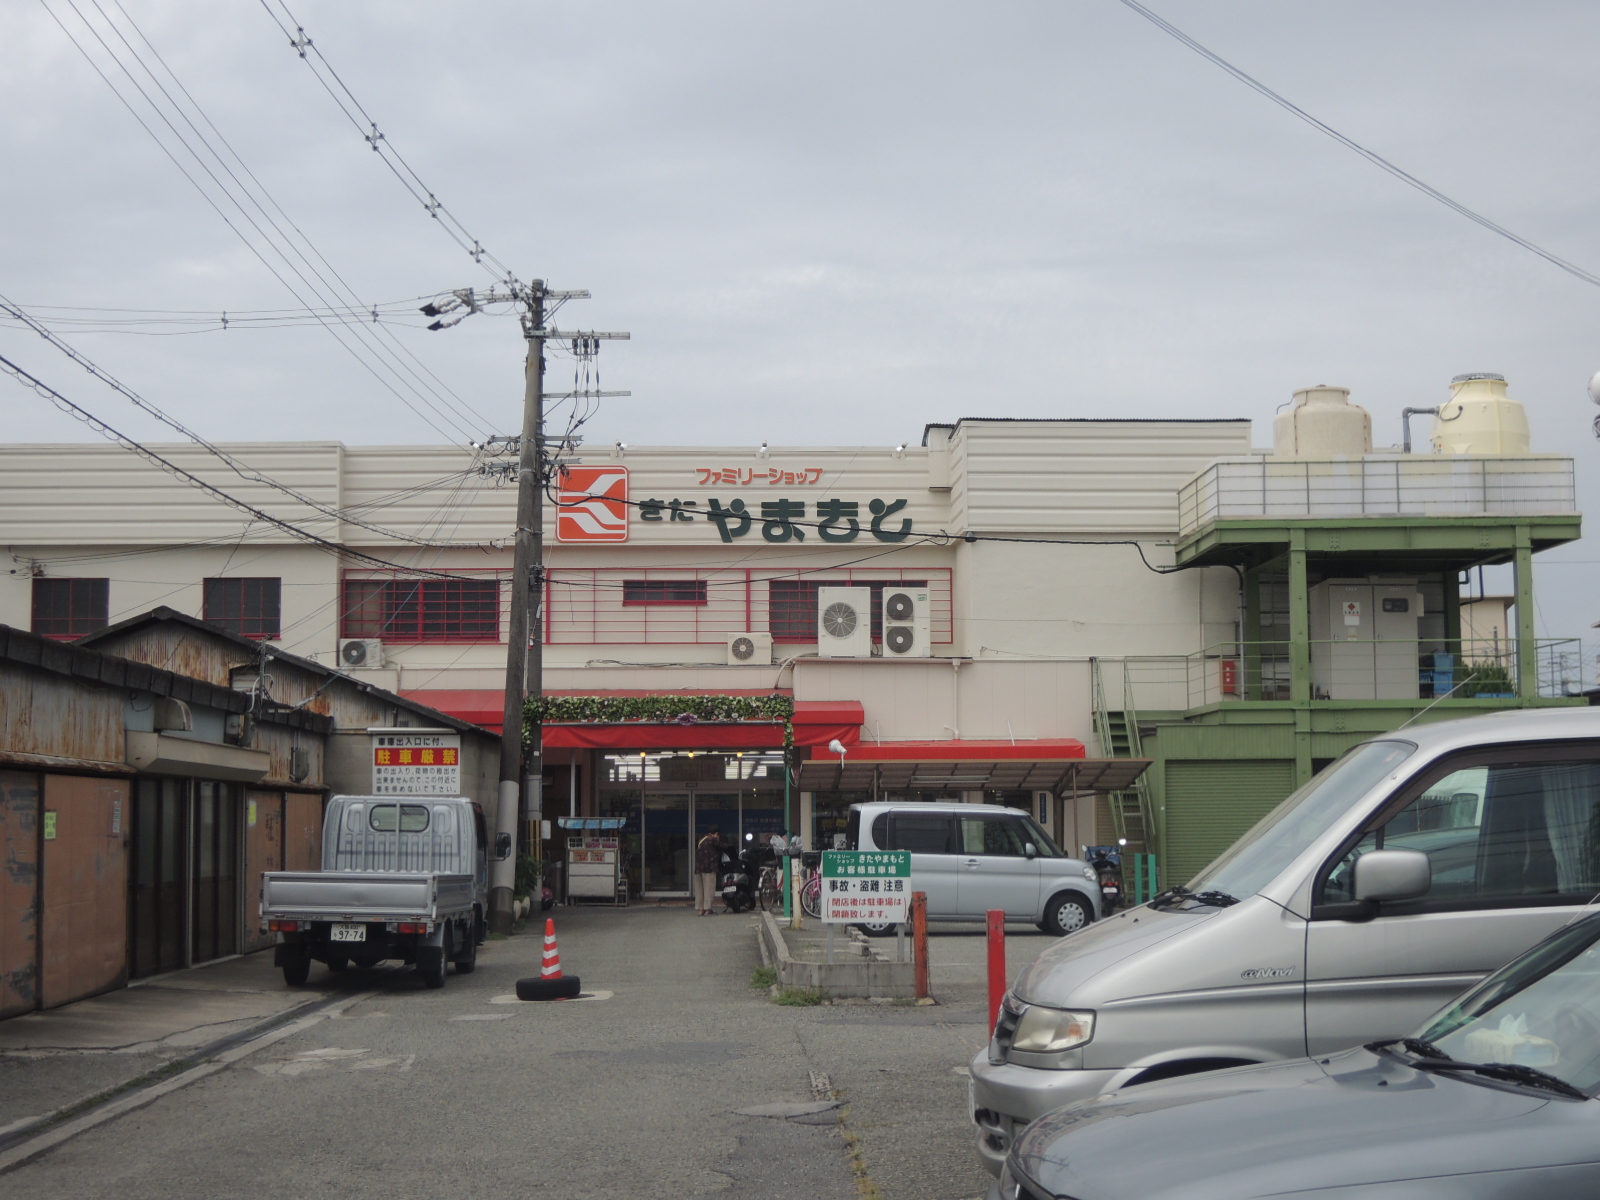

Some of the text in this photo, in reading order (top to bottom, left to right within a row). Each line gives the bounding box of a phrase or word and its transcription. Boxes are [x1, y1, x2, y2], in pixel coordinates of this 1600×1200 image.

[695, 467, 824, 485] ファミリーショップ
[638, 497, 913, 544] きた やまもと
[377, 749, 456, 764] 駐車厳禁
[858, 854, 905, 863] きたやまもと
[837, 866, 896, 874] お客様駐車場
[829, 880, 904, 892] 事故・盗難 注意
[338, 930, 364, 940] 97-74
[1241, 966, 1296, 980] @Navi
